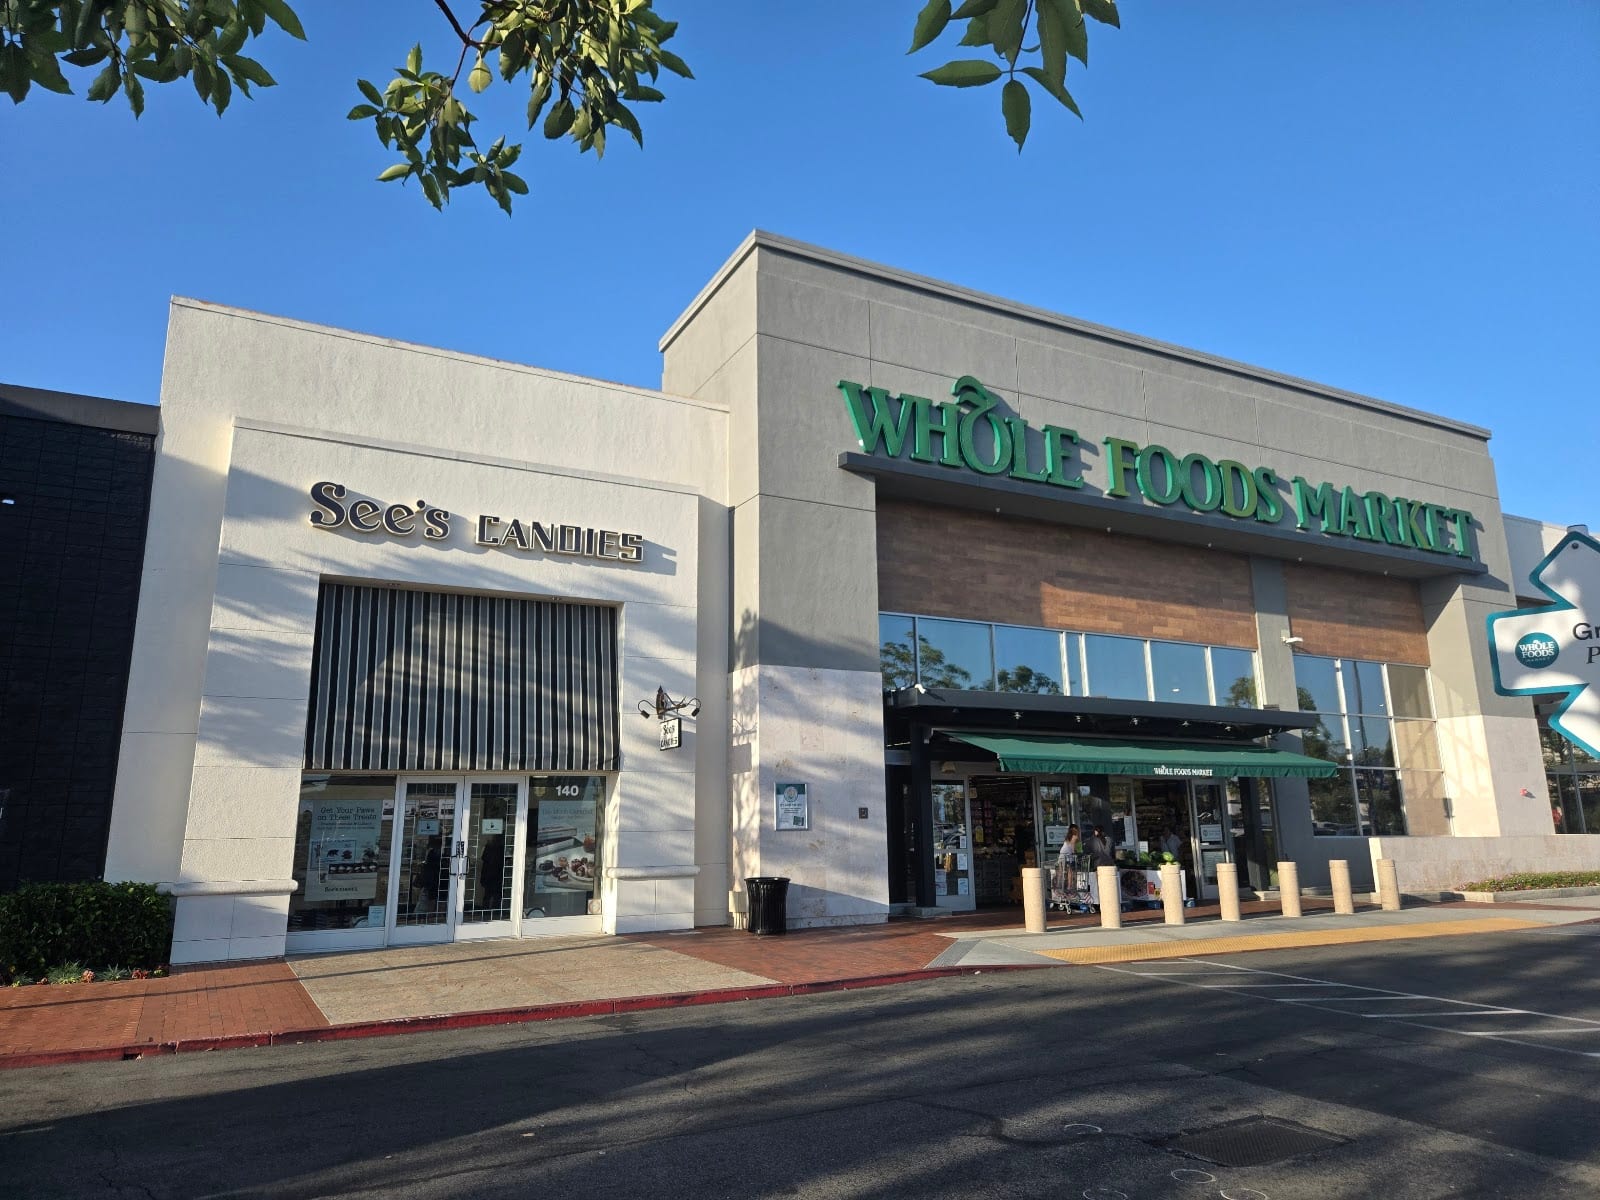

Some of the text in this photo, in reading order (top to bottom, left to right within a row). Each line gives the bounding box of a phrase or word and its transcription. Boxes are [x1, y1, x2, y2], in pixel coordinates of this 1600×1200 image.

[837, 375, 1474, 560] WHOLE FOODS MARKET
[309, 480, 645, 563] See's CANDIES
[1519, 640, 1555, 652] WHOLE
[1522, 649, 1555, 659] FOODS
[1153, 764, 1173, 776] WHOLE
[1173, 768, 1192, 776] FOODS
[555, 785, 579, 797] 140
[320, 806, 334, 814] Get
[335, 806, 353, 814] Your
